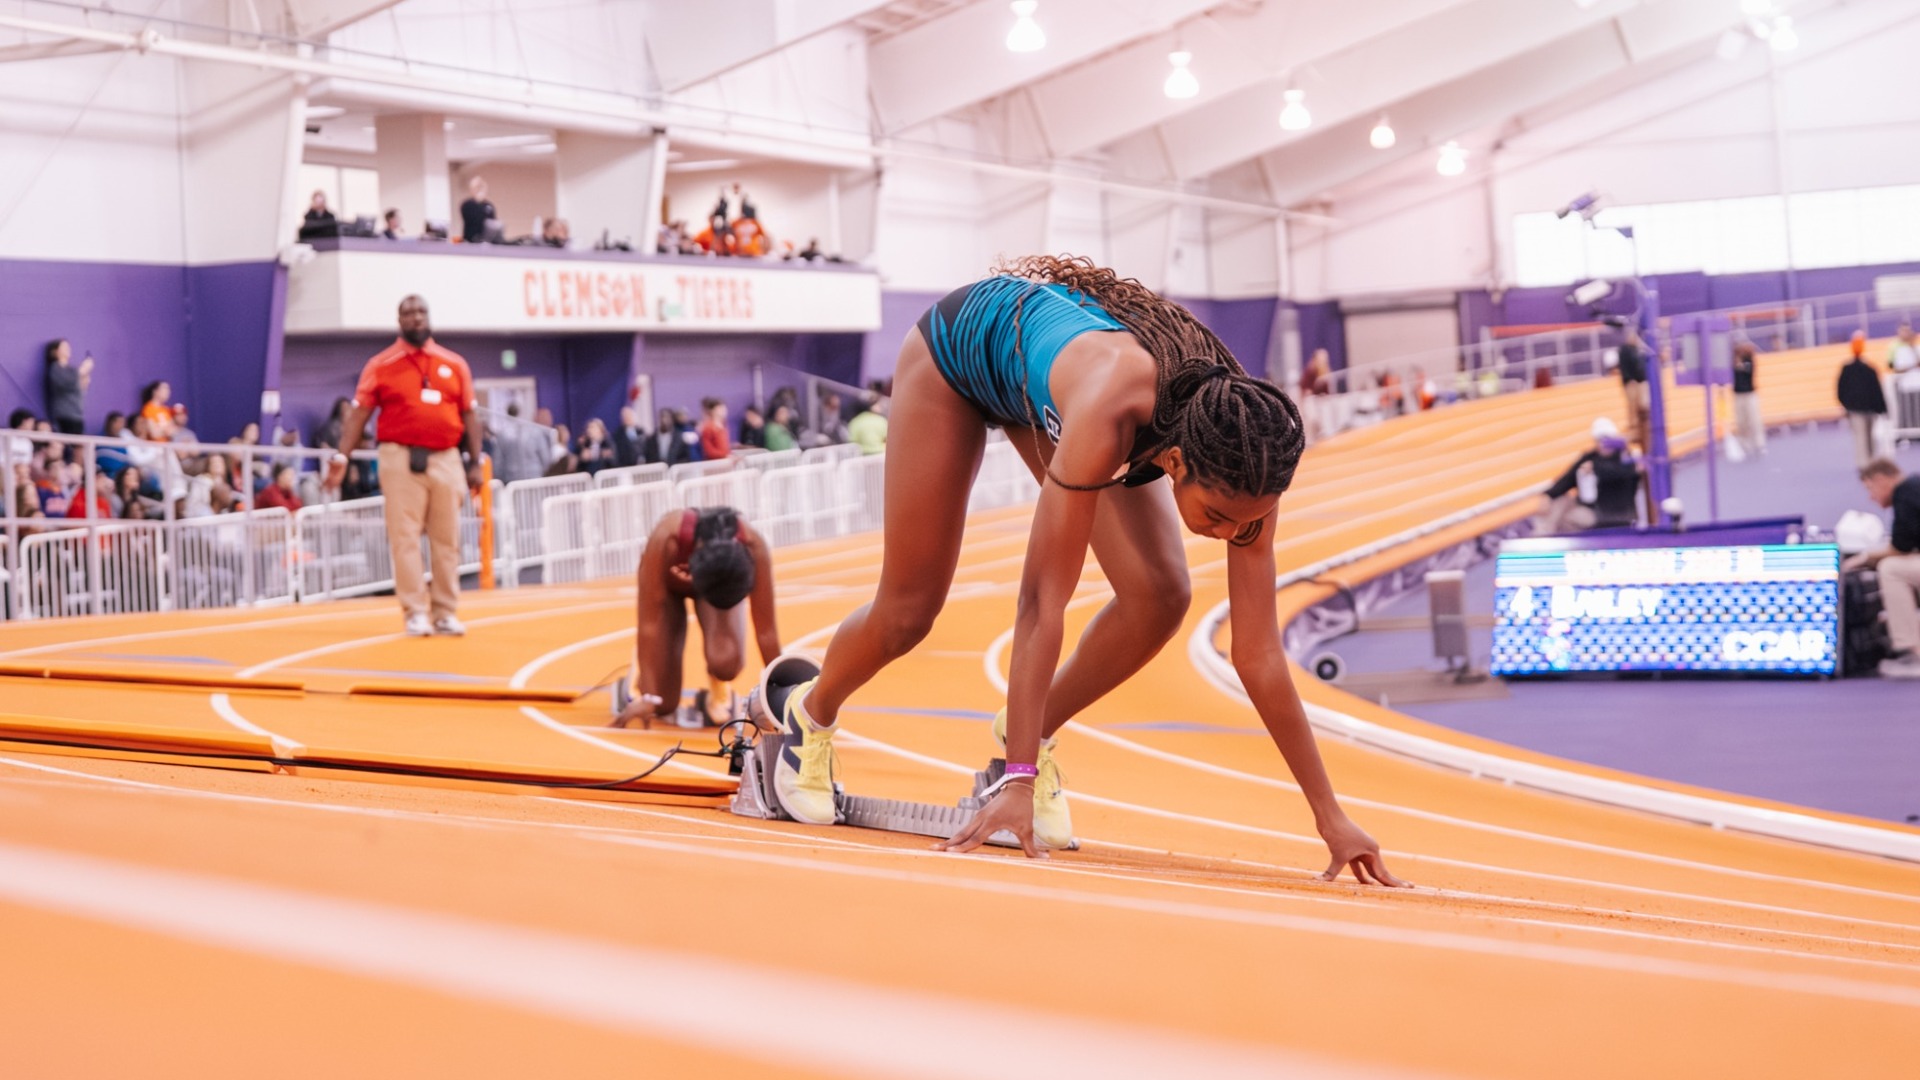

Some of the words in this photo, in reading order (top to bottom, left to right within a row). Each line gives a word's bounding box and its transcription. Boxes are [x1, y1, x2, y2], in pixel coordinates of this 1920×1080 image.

[676, 275, 754, 320] TIGERS
[1510, 585, 1533, 619] 4
[1722, 630, 1826, 661] CCAR
